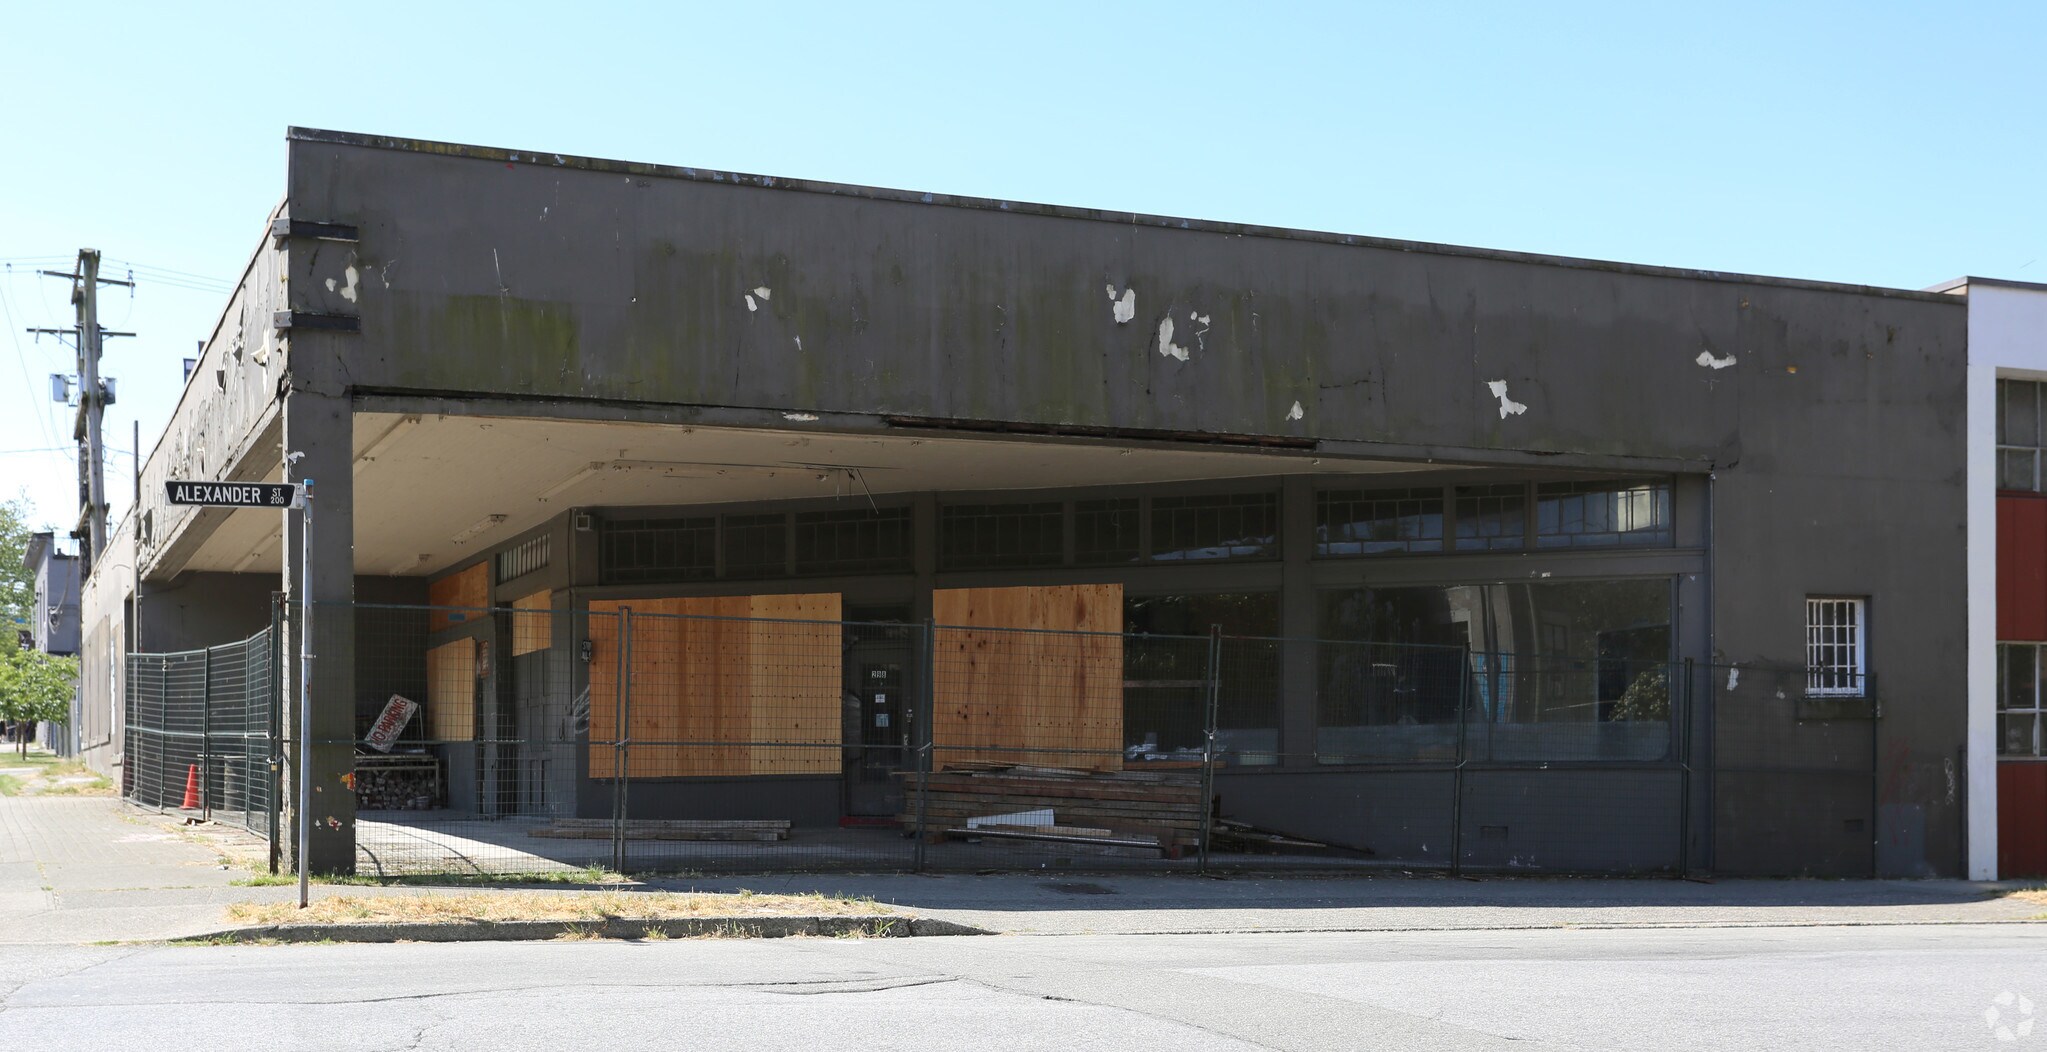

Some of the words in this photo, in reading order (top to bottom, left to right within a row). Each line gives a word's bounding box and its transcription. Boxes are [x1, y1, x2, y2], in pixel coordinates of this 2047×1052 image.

[175, 485, 261, 503] ALEXANDER
[272, 487, 282, 497] ST
[270, 496, 284, 504] 200
[377, 698, 407, 733] PARKING
